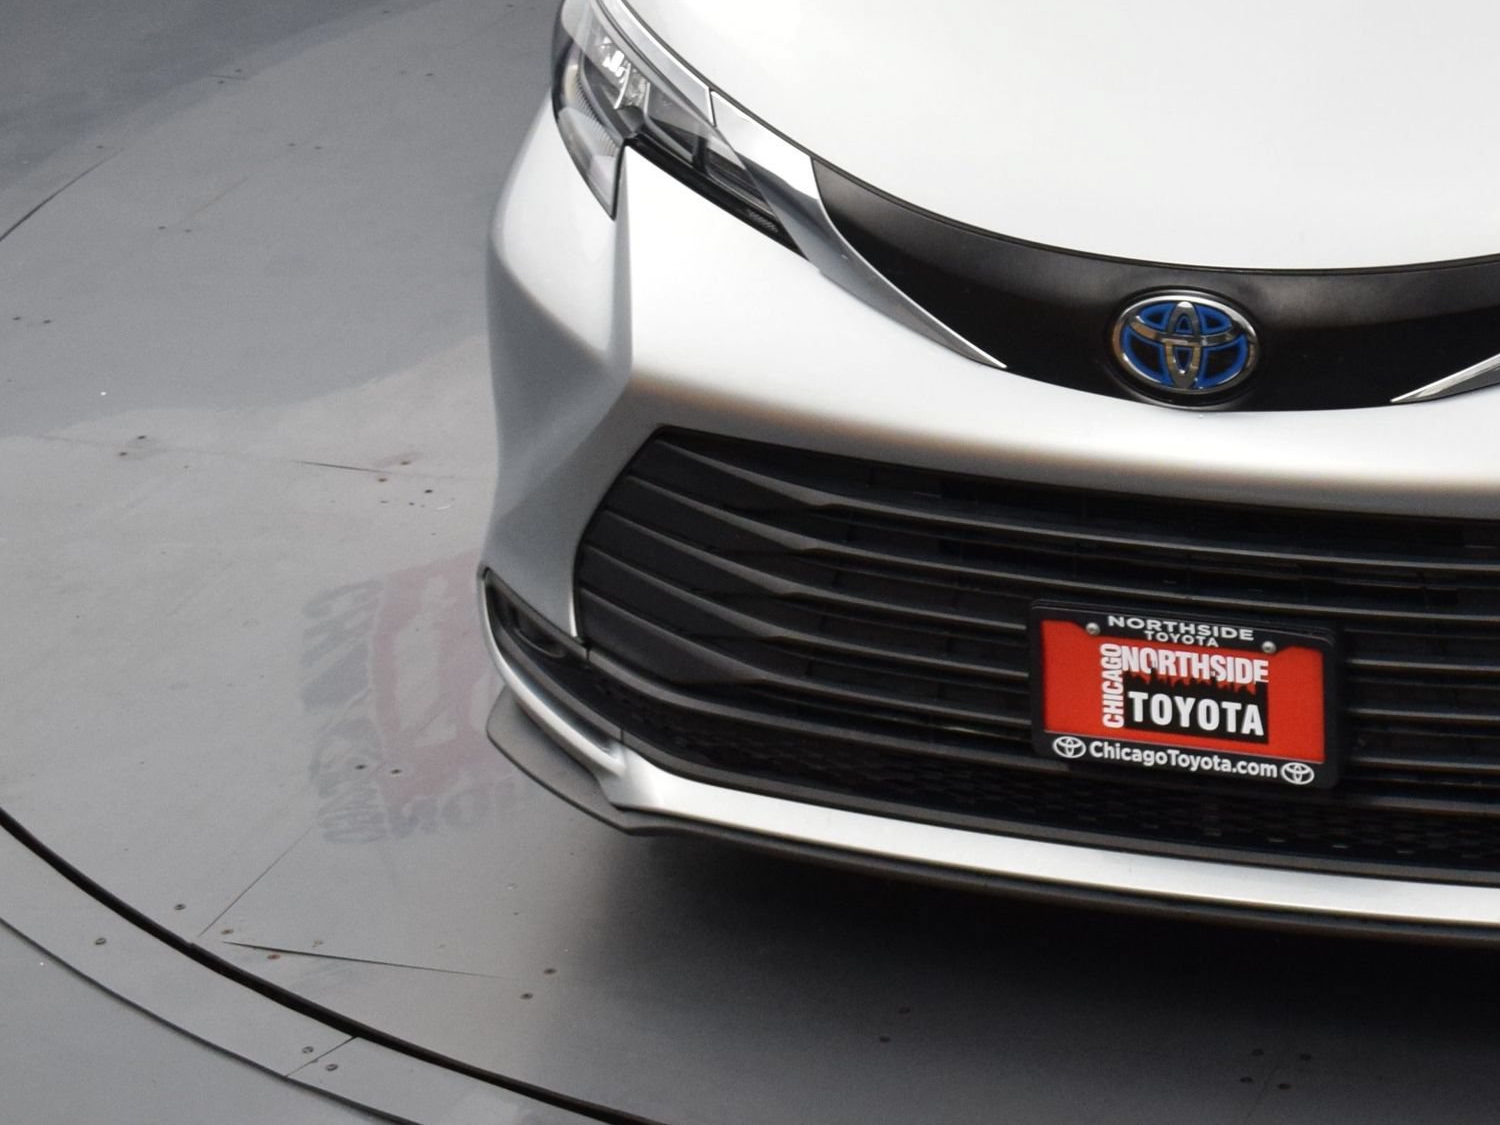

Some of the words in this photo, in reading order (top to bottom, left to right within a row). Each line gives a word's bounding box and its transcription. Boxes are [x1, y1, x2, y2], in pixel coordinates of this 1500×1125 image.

[1107, 615, 1254, 641] NORTHSIDE
[1144, 630, 1219, 648] TOYOTA
[1122, 645, 1269, 684] NORTHSIDE
[1100, 643, 1125, 728] CHICAGO
[1128, 691, 1264, 736] TOYOTA
[1089, 741, 1278, 778] ChicagoToyota.com
